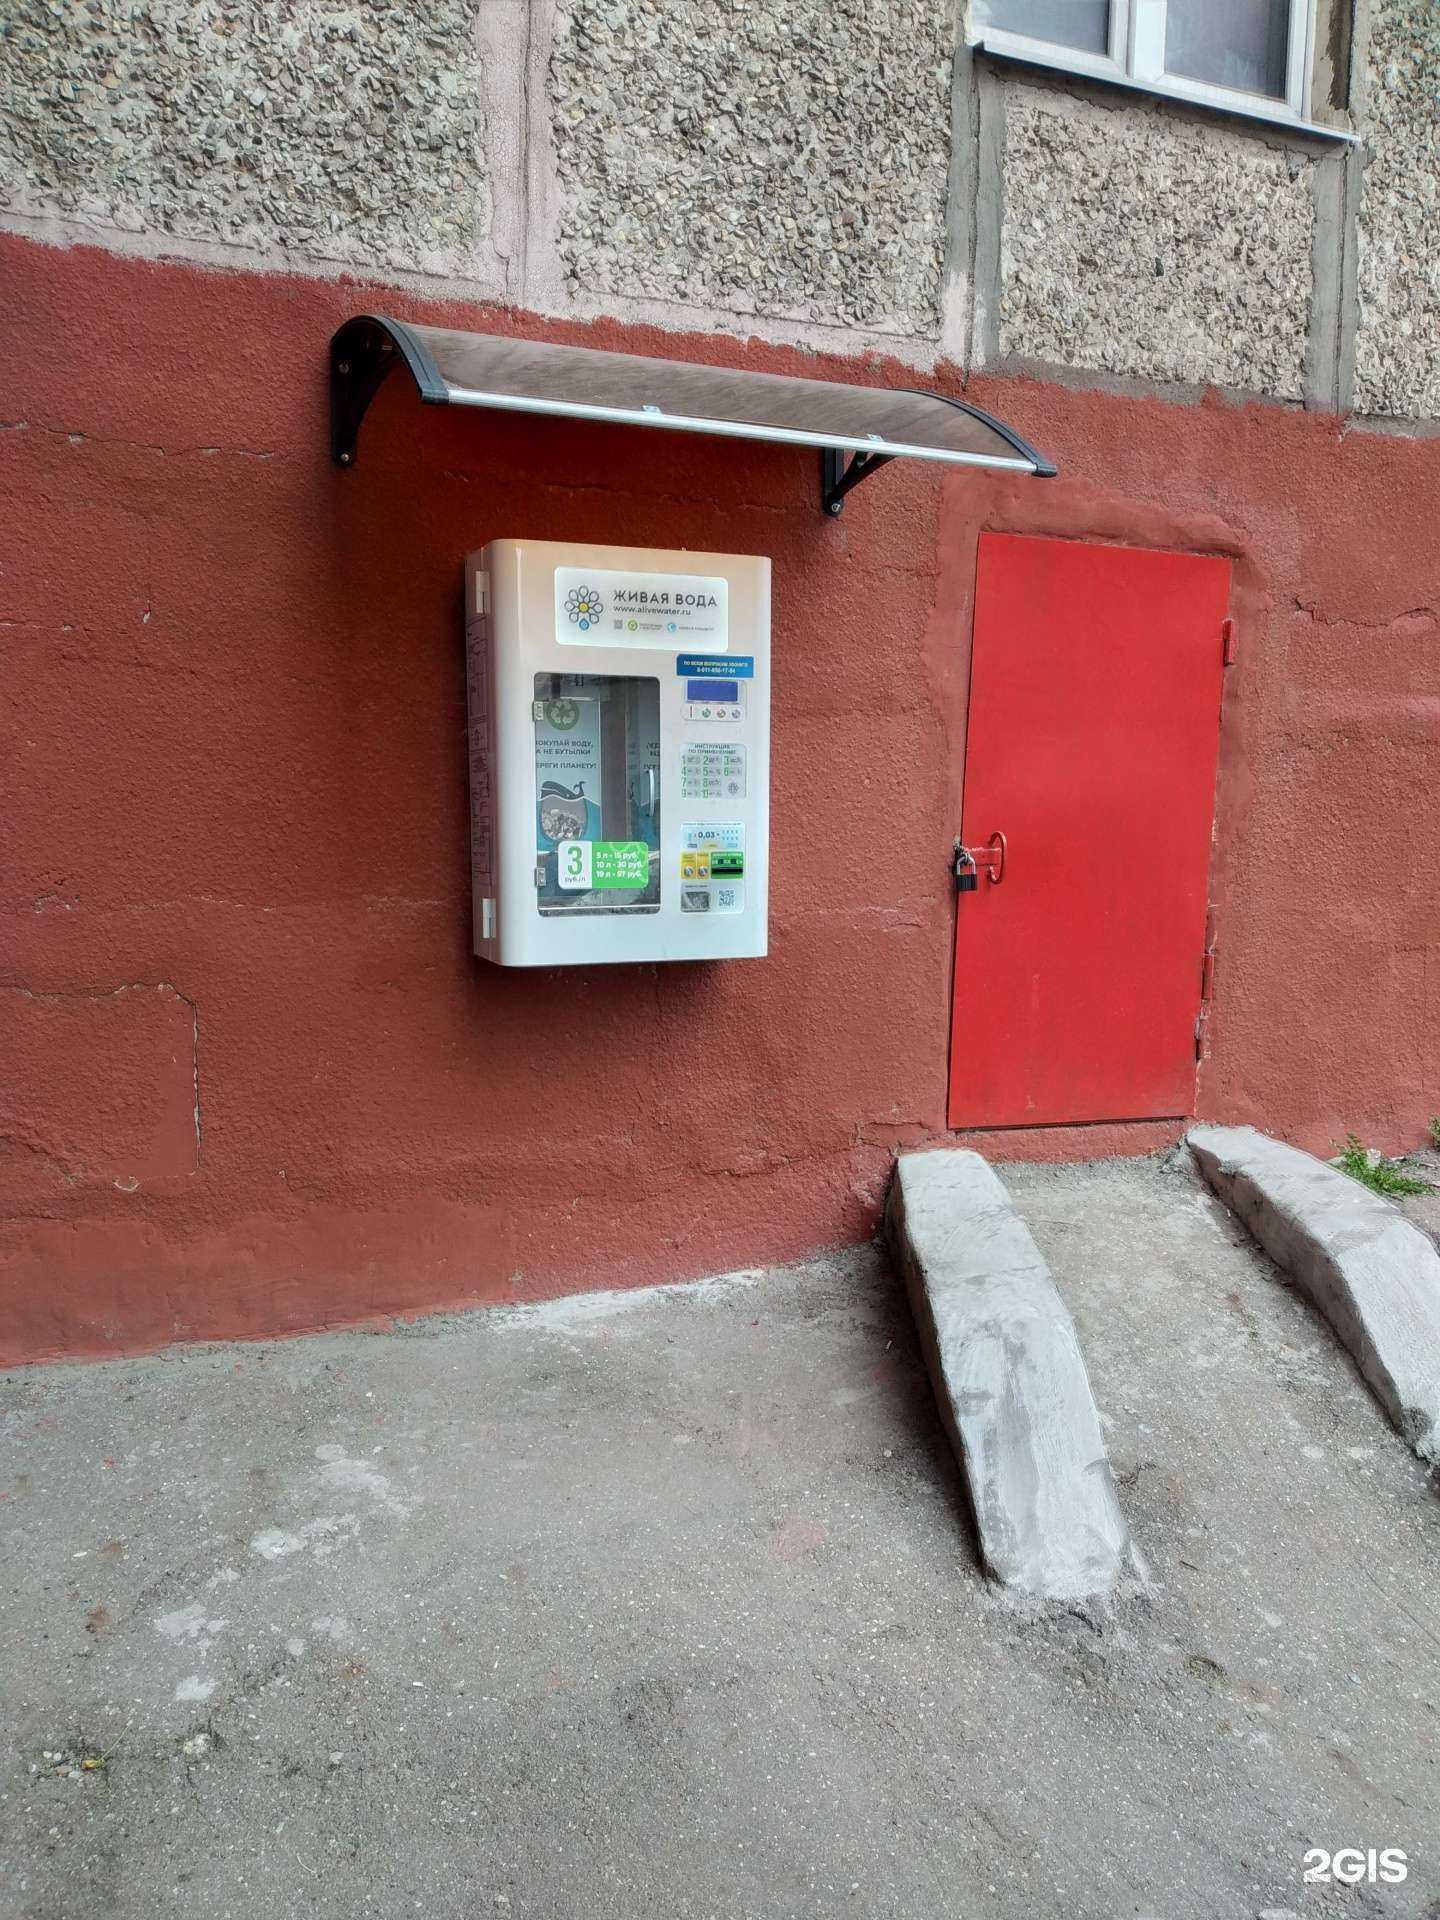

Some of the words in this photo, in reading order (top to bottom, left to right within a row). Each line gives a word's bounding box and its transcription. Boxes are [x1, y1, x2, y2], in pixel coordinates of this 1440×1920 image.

[614, 590, 669, 604] ЖИВАЯ
[675, 593, 718, 608] ВОДА
[613, 605, 691, 616] www.alivewater.ru
[567, 846, 583, 875] 3
[596, 870, 605, 878] 19
